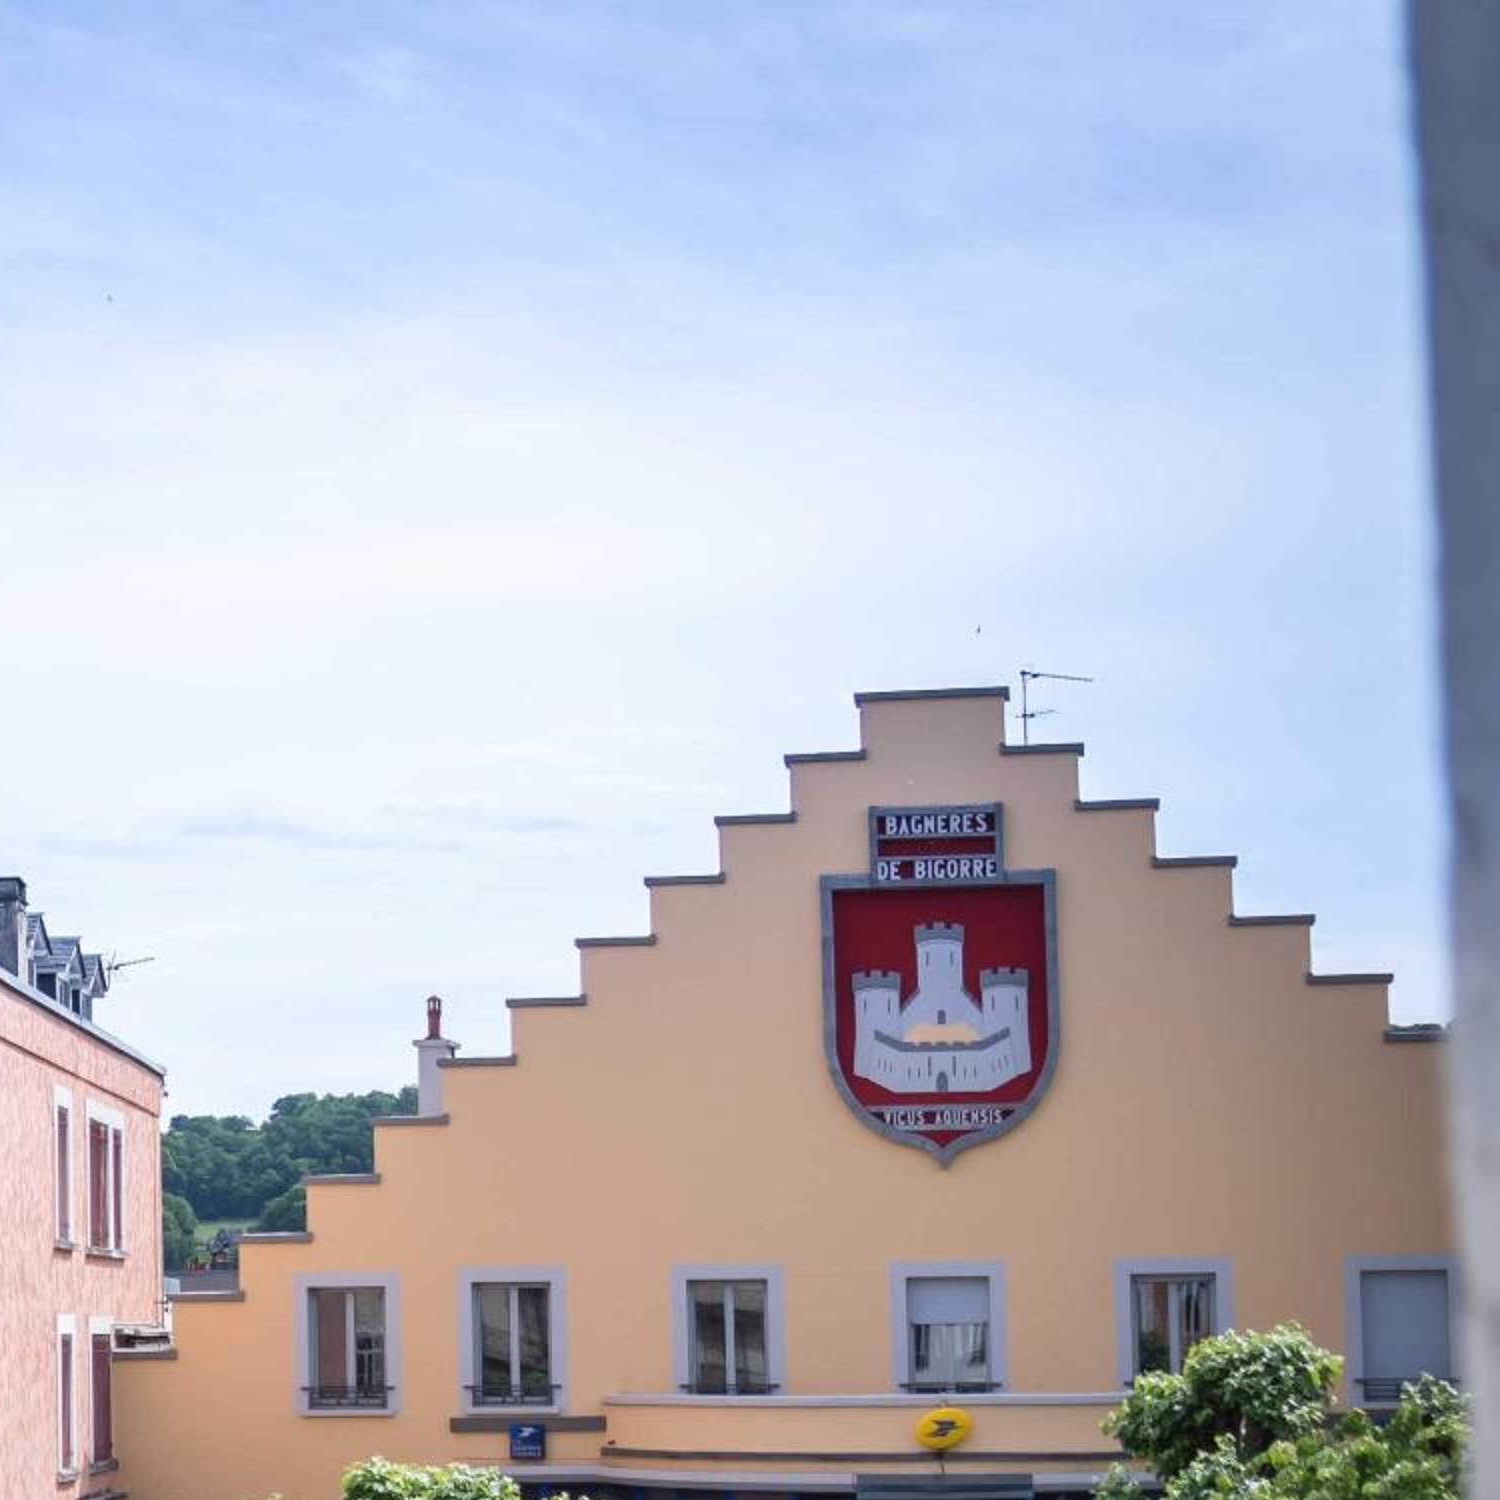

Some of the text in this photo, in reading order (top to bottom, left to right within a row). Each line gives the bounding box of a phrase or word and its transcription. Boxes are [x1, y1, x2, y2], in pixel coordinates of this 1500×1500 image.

[885, 813, 988, 835] BAGNERES
[877, 858, 997, 881] DE BIGORRE
[884, 1109, 926, 1126] VICUS
